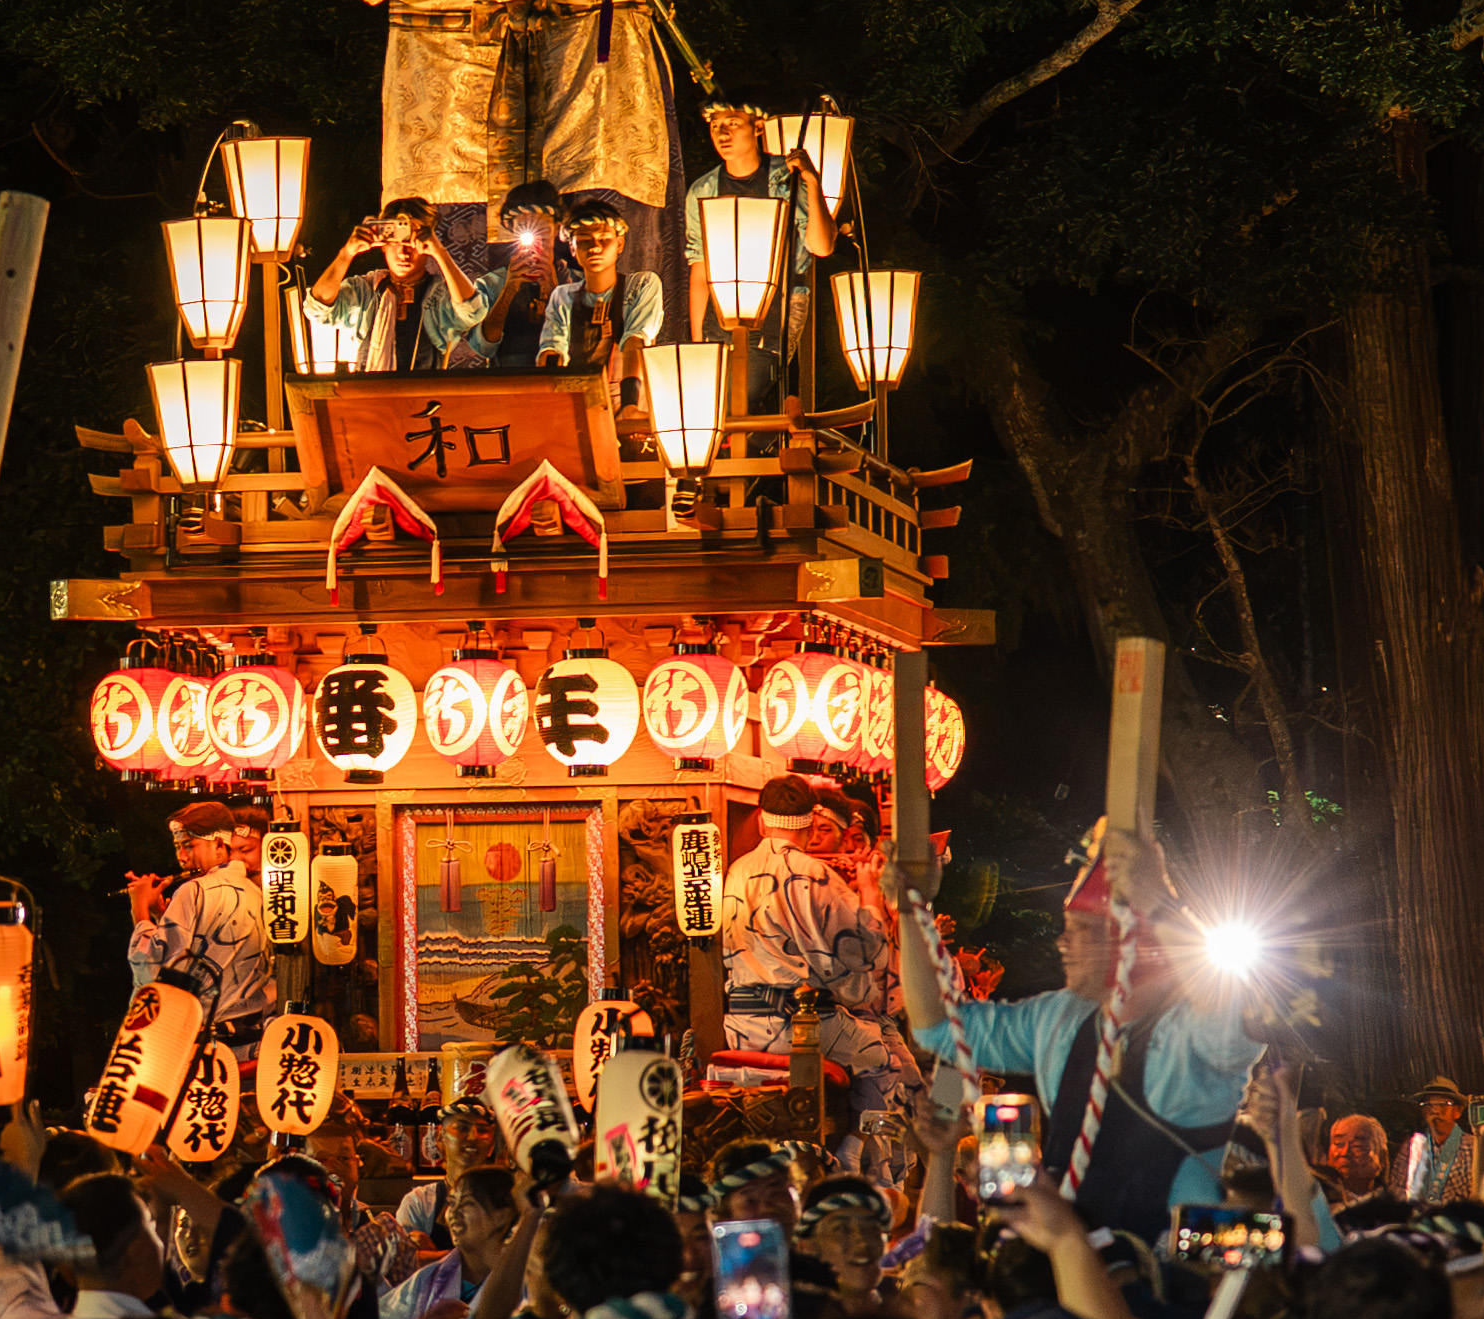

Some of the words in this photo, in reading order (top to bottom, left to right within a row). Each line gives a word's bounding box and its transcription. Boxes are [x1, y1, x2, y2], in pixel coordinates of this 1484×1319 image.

[405, 400, 511, 478] 和
[314, 670, 397, 757] 番
[184, 1052, 229, 1152] 小惣代
[272, 1023, 323, 1124] 小惣代
